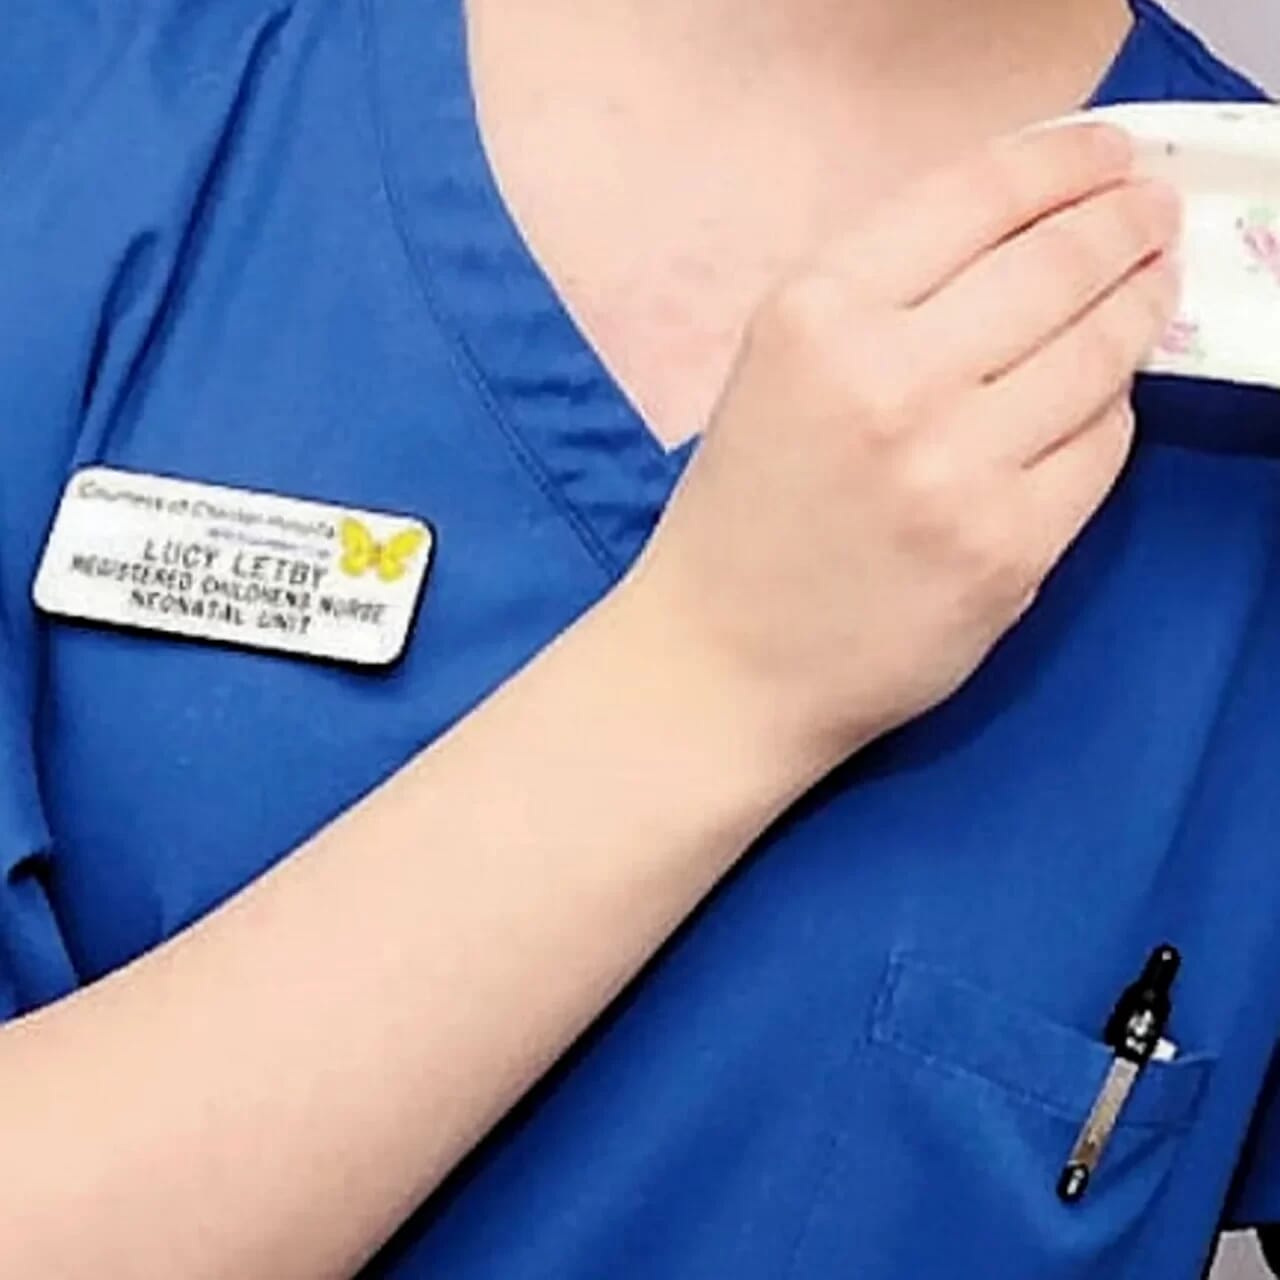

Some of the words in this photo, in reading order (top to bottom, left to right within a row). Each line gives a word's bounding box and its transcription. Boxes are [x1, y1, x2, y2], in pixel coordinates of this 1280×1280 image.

[143, 537, 218, 569] LUCY
[231, 550, 329, 591] LETBY
[131, 589, 244, 627] NEONATAL
